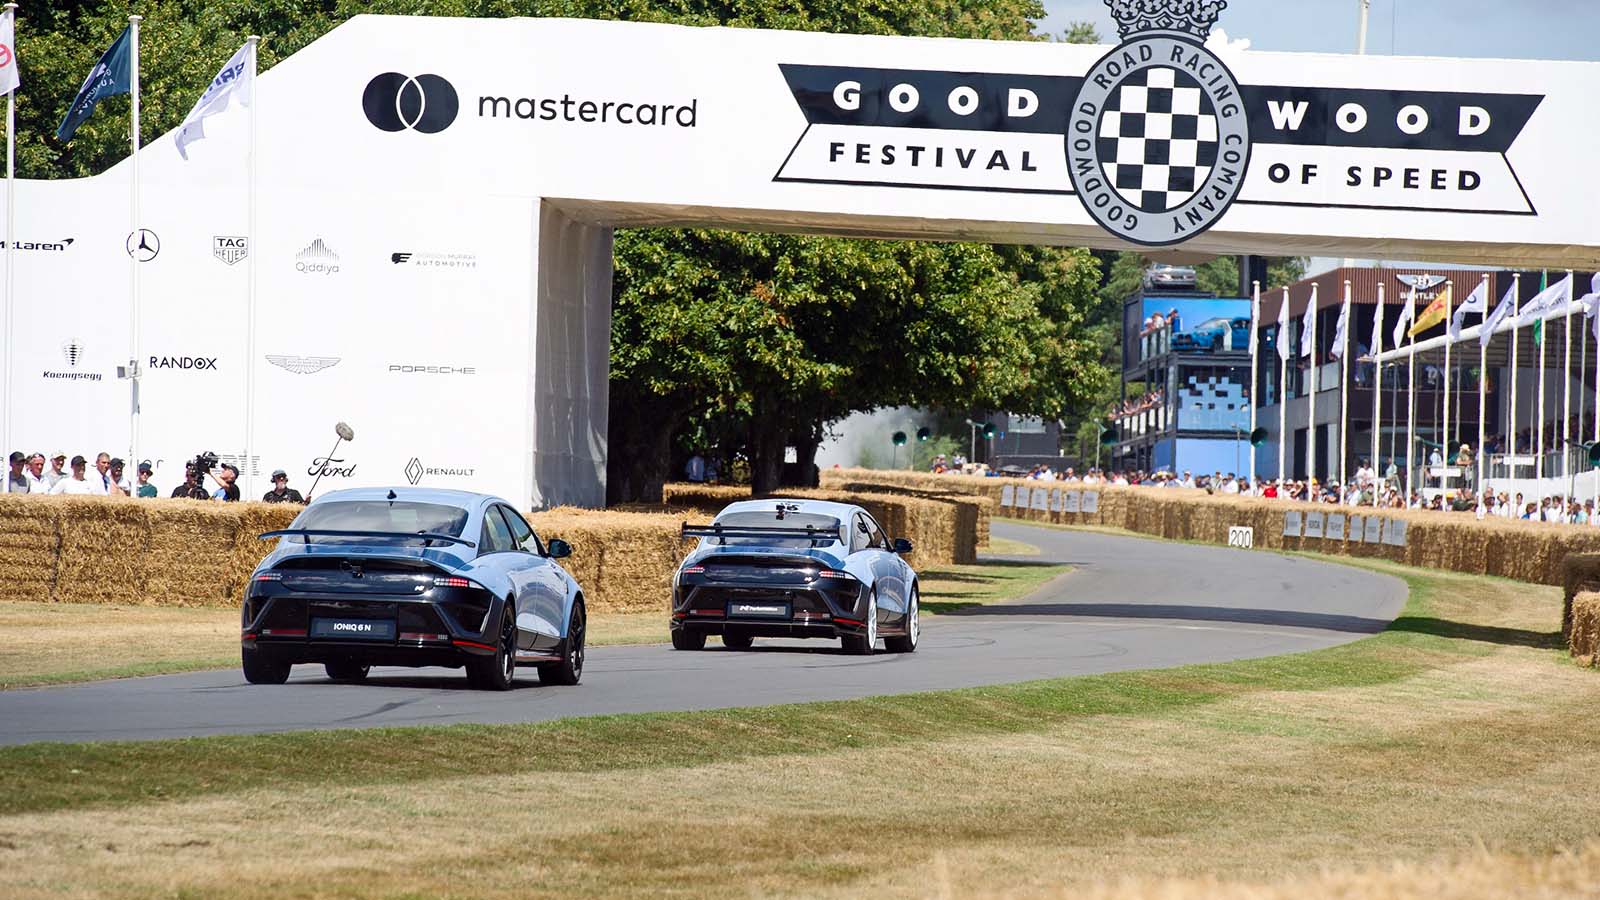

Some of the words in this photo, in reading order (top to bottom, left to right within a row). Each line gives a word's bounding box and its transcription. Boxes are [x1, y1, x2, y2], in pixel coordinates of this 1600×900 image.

[1093, 44, 1153, 90] ROAD
[1170, 45, 1239, 119] RACING
[478, 93, 698, 128] mastercard
[832, 80, 1039, 118] GOOD
[1266, 100, 1492, 136] WOOD
[829, 141, 1038, 172] FESTIVAL
[1267, 162, 1318, 185] OF
[1346, 165, 1482, 191] SPEED
[1074, 101, 1138, 230] GOODWOOD
[1173, 133, 1243, 234] COMPANY
[217, 238, 245, 248] TAG
[215, 249, 246, 263] HEUER
[295, 261, 340, 276] Qiddiya
[1400, 291, 1440, 300] BTLE
[149, 356, 217, 370] RANDOX
[389, 365, 476, 375] PORSCHE
[42, 370, 102, 381] Koenigsegg
[307, 456, 357, 479] Ford
[426, 468, 475, 476] RENAULT
[1230, 529, 1251, 549] 200
[333, 622, 357, 632] IONIQ
[357, 623, 364, 632] 6
[364, 623, 372, 632] N
